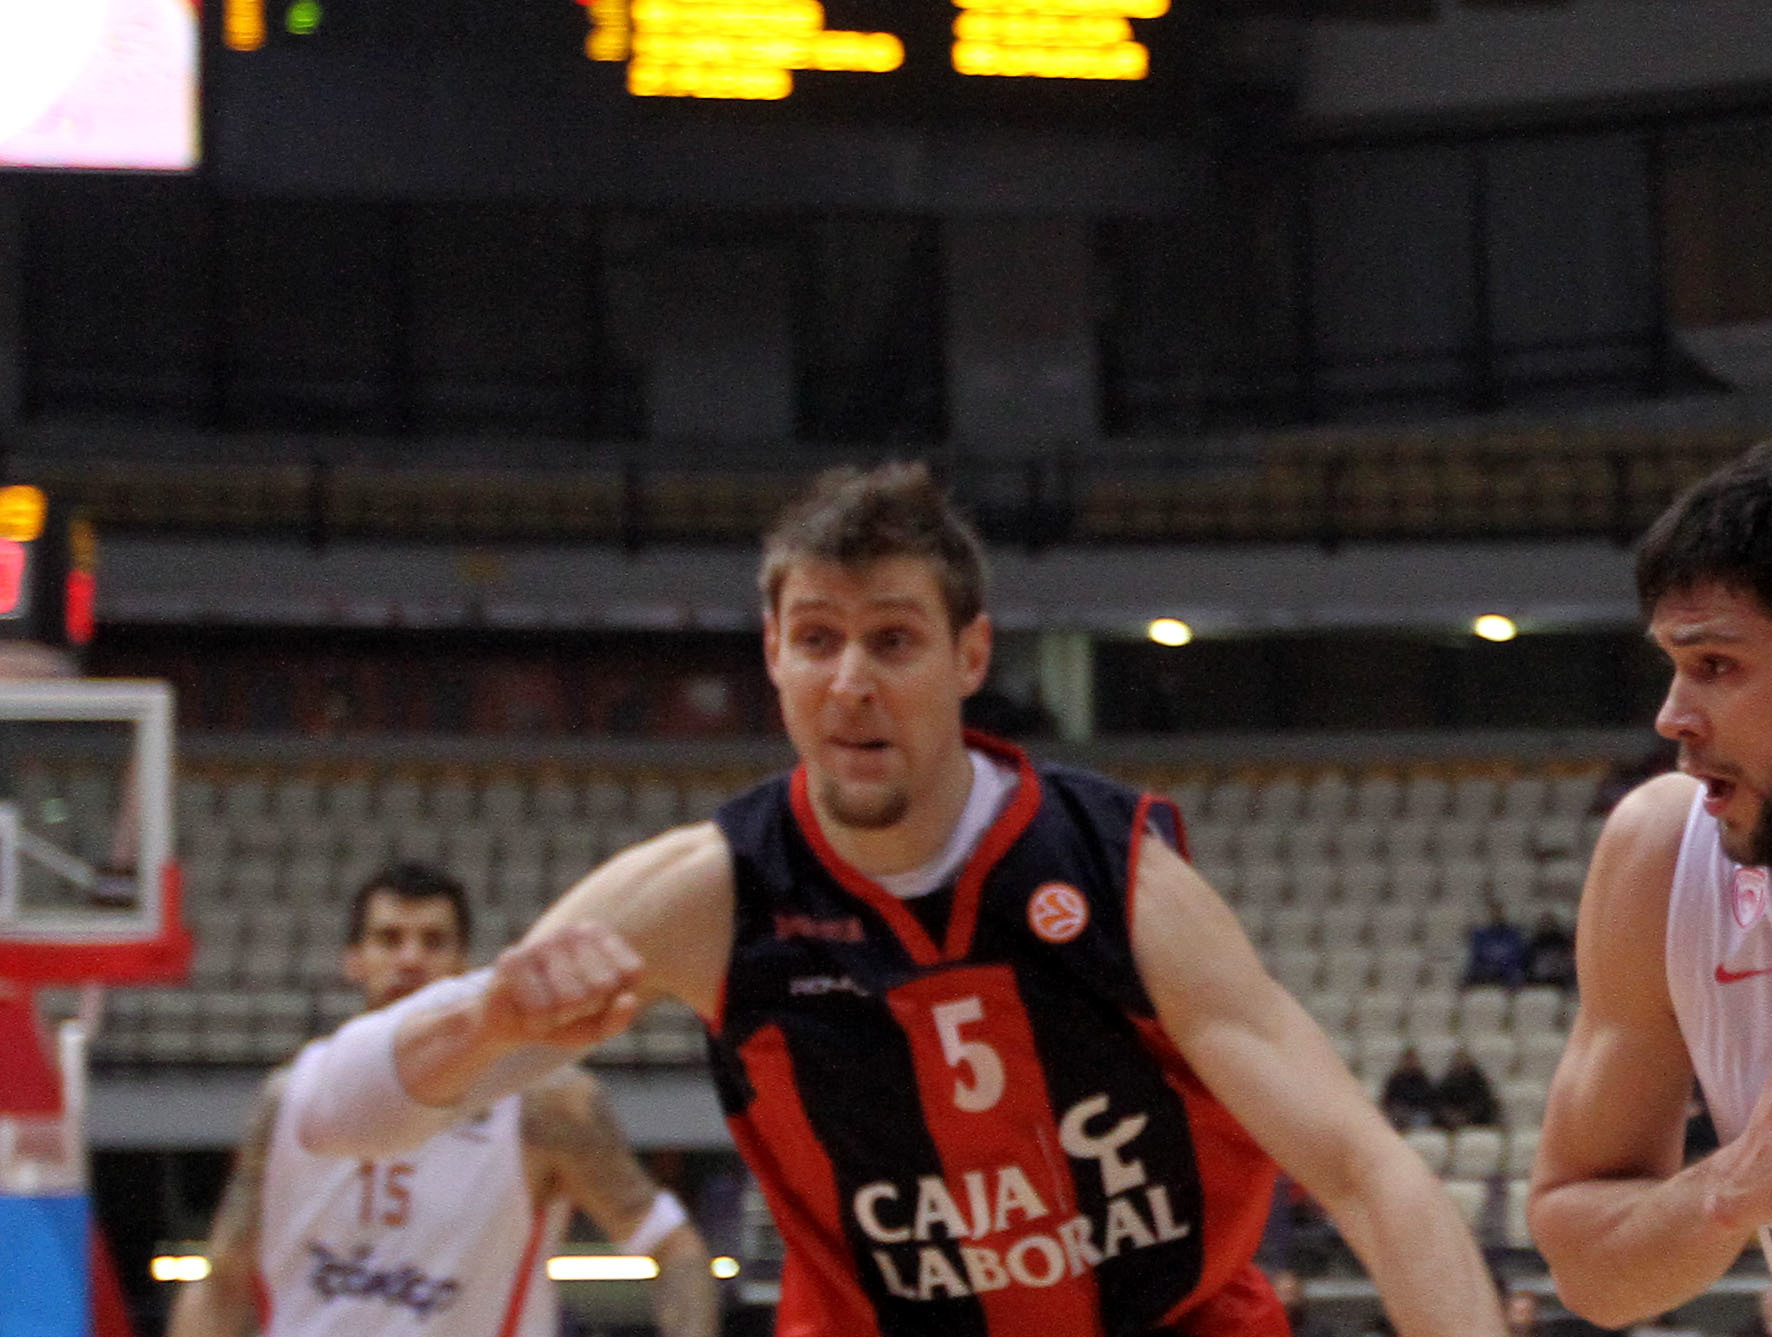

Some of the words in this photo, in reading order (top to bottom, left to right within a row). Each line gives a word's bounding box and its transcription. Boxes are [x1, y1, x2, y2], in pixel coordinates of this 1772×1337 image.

[932, 996, 1006, 1112] 5
[357, 1160, 416, 1228] 15
[853, 1165, 1049, 1243] CAJA
[871, 1184, 1190, 1300] LABORAL
